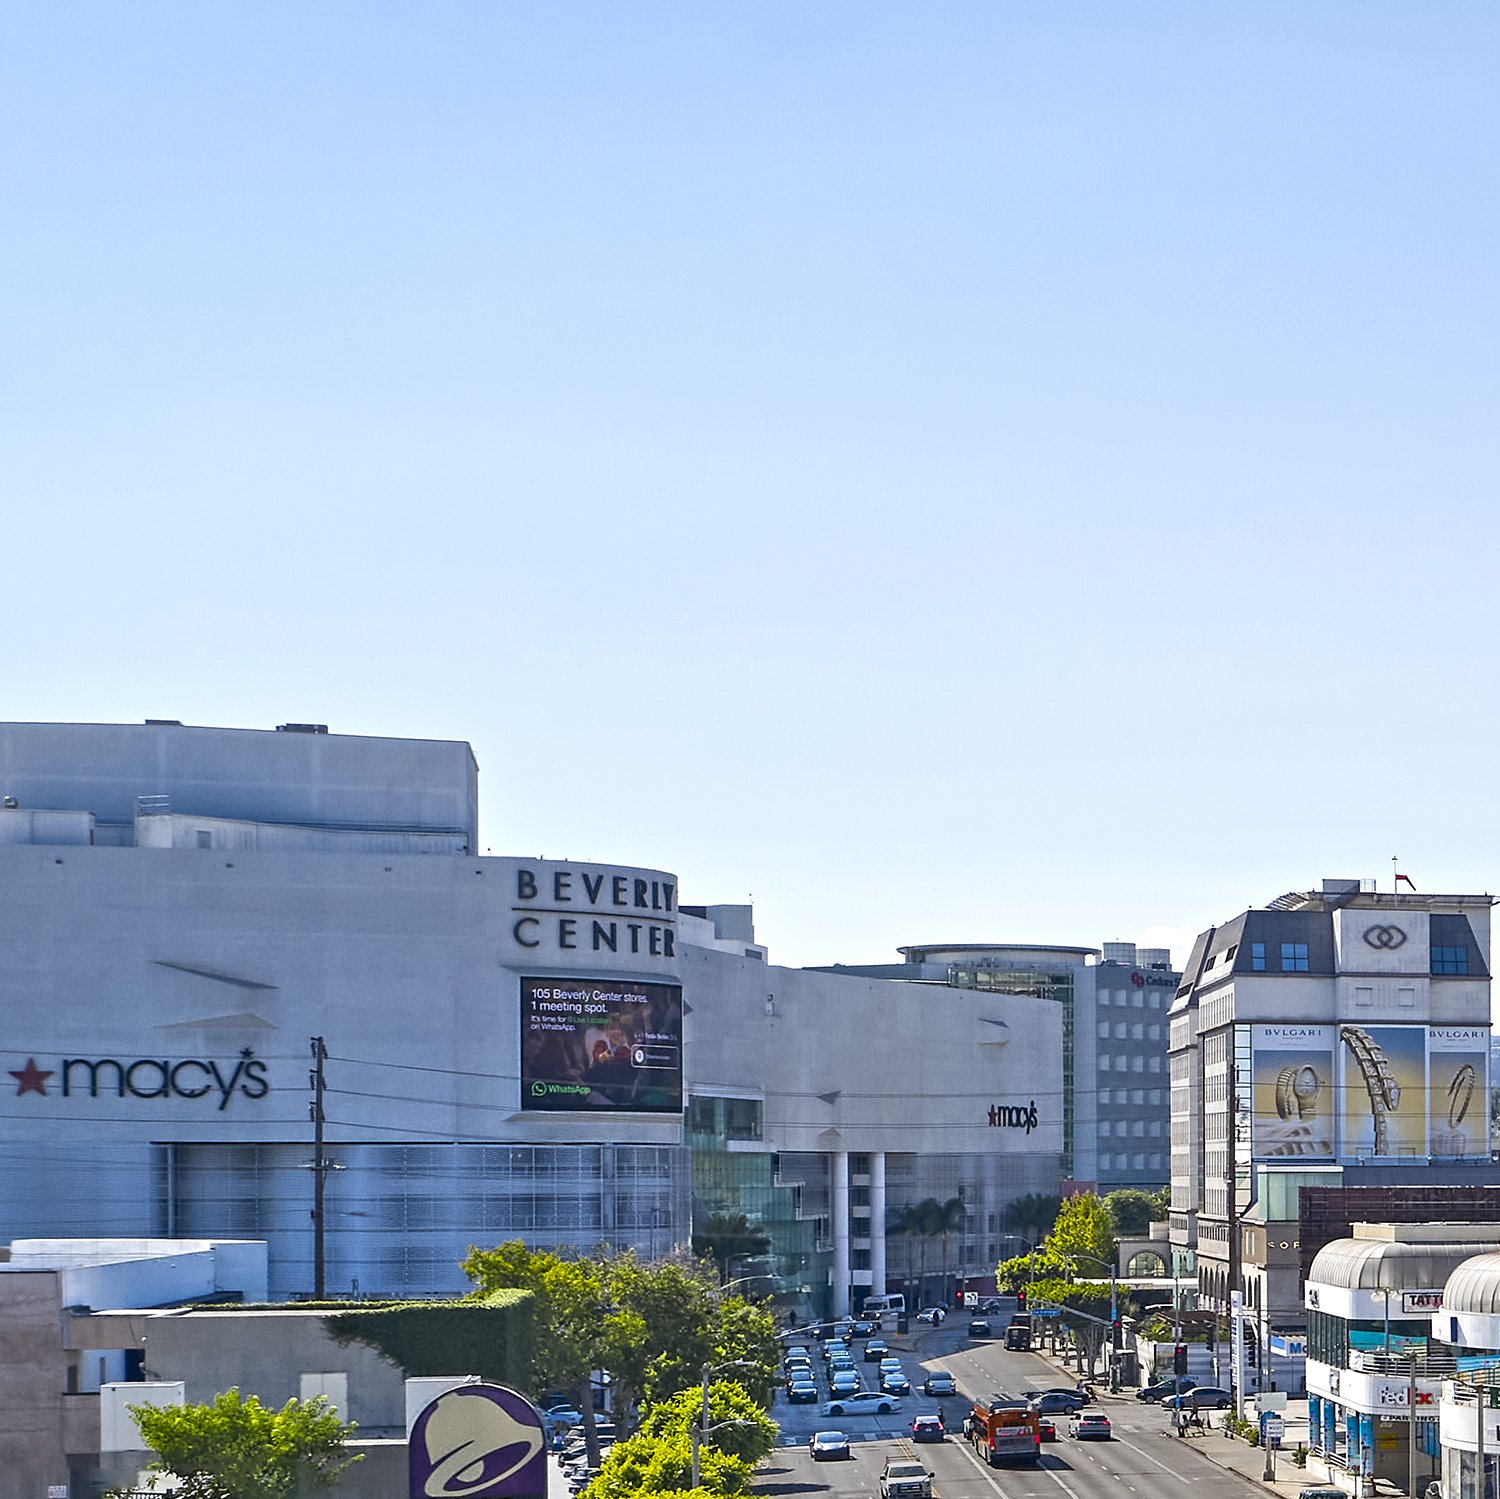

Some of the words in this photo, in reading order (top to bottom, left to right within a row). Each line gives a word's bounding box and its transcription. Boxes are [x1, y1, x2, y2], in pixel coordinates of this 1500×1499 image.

[518, 870, 674, 911] BEVERLY
[513, 917, 675, 957] CENTER
[531, 989, 550, 999] 105
[553, 989, 590, 1001] Beverly
[593, 991, 622, 1001] Center
[531, 1001, 537, 1010] 1
[540, 1002, 582, 1014] meeting
[585, 1004, 608, 1013] spot.
[1430, 1030, 1485, 1038] BVLGARI
[62, 1047, 268, 1110] macy's
[548, 1085, 591, 1095] WhatsApp
[998, 1100, 1038, 1135] macy's
[1409, 1295, 1444, 1307] TATT
